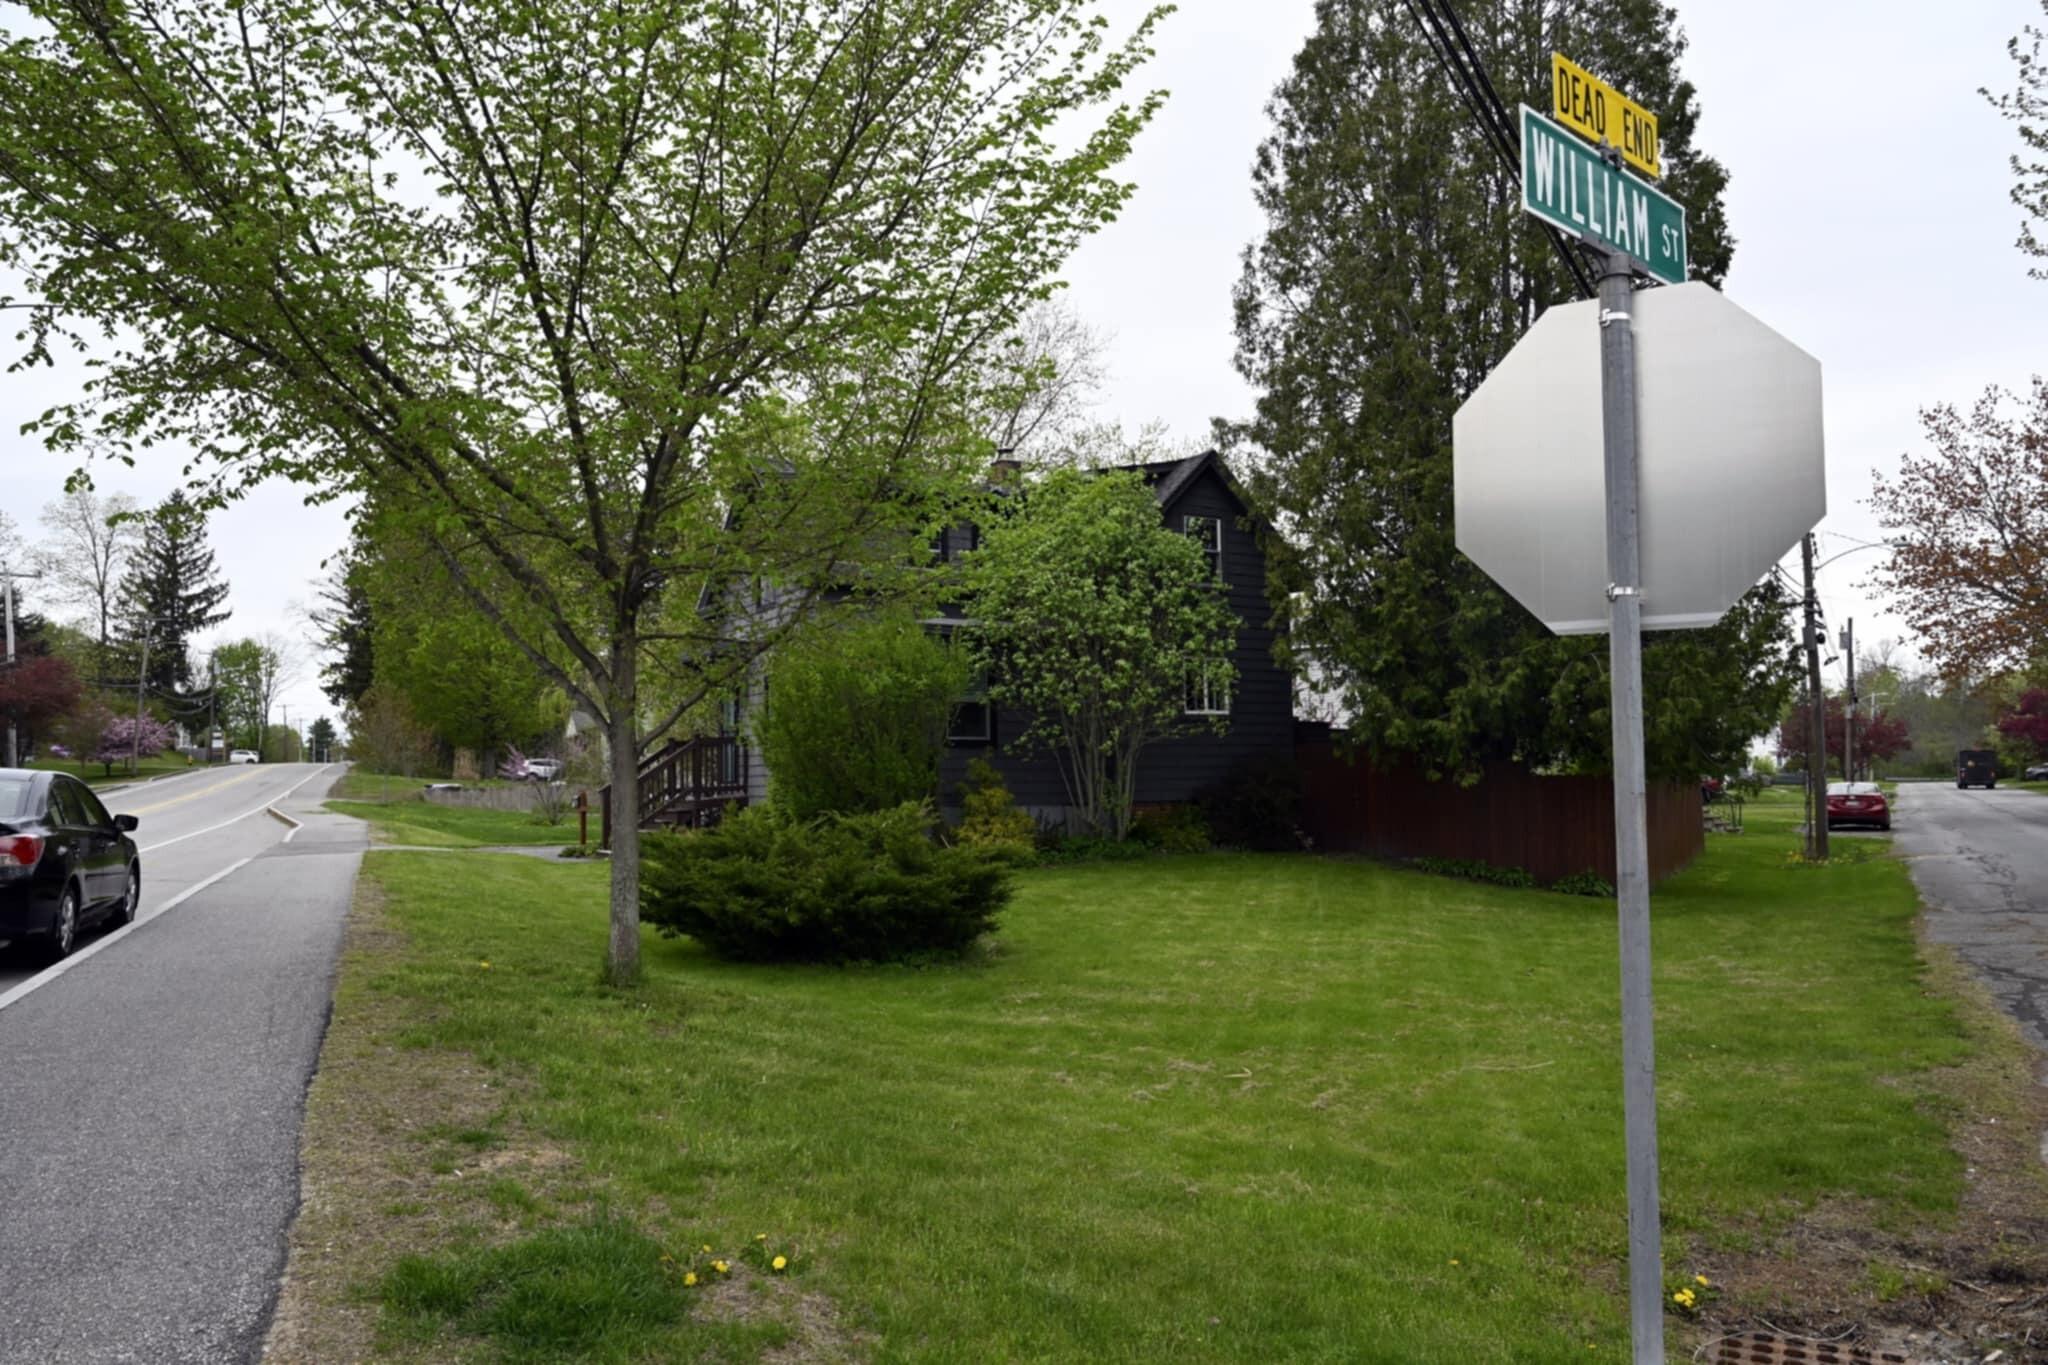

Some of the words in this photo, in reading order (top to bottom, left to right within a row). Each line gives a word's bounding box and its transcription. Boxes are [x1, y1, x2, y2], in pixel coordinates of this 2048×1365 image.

[1558, 66, 1606, 136] DEAD
[1623, 107, 1653, 166] END
[1532, 126, 1650, 262] WILLIAM
[1661, 223, 1679, 263] ST
